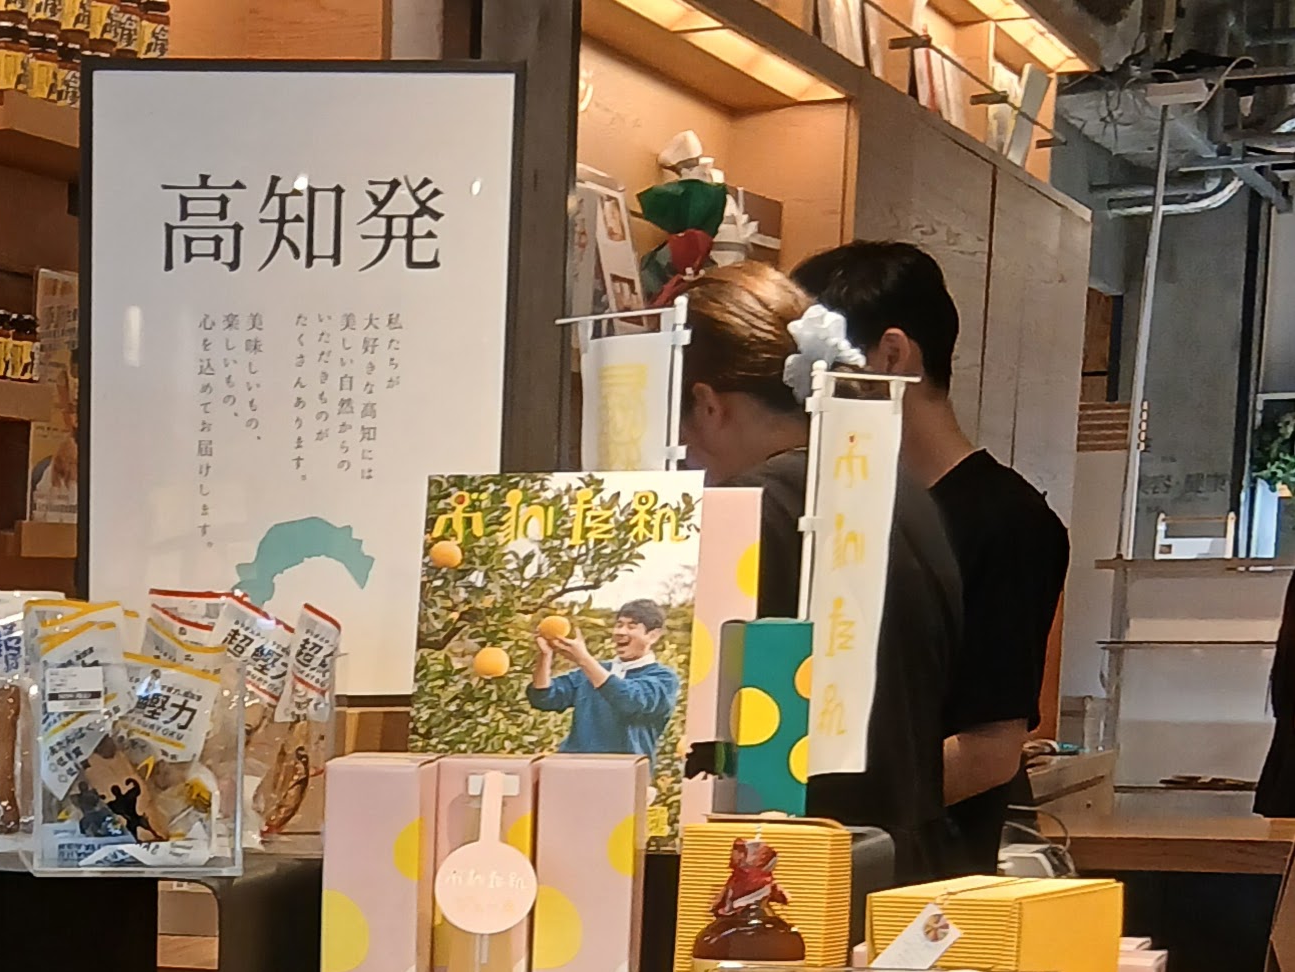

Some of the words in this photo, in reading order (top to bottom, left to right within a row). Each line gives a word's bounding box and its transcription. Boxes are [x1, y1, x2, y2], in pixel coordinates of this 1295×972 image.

[160, 173, 445, 273] 高知発
[315, 313, 333, 443] いただきものが
[337, 312, 358, 472] 美しい自然からの
[360, 312, 381, 481] 大好きな高知には
[386, 312, 404, 390] 私たちが
